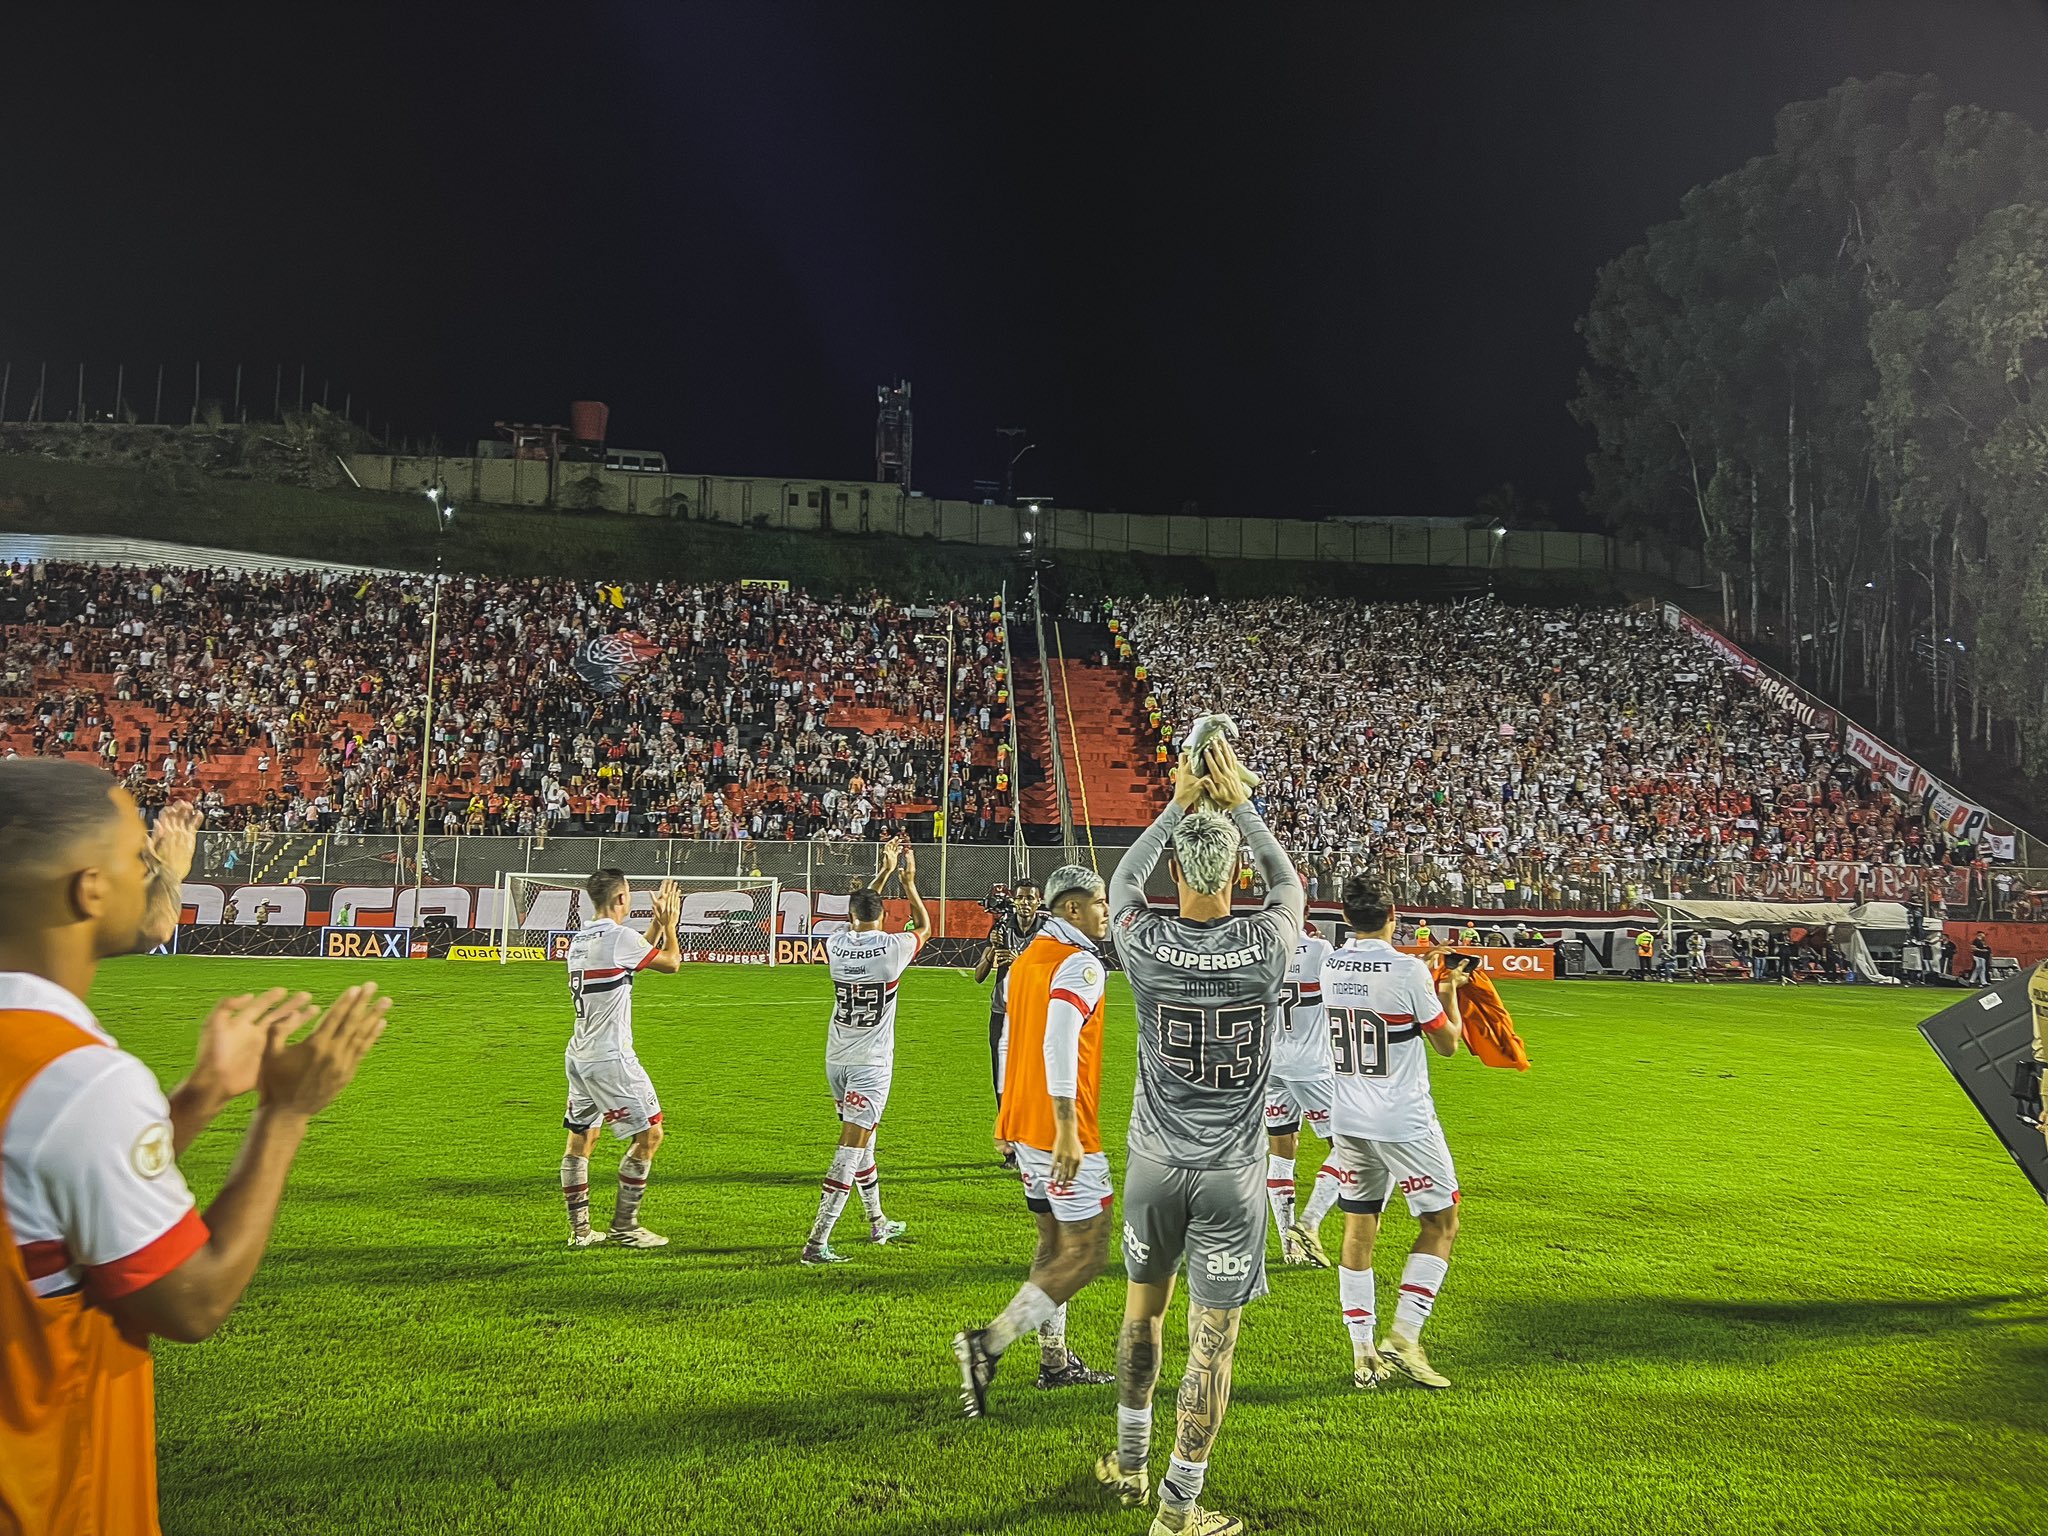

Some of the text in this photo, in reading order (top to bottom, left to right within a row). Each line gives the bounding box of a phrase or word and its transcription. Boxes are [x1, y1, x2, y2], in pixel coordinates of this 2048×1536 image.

[329, 932, 401, 957] BRAX
[778, 940, 829, 964] BRA
[832, 945, 887, 959] SUPERBET
[456, 948, 540, 960] quartzolit
[1155, 944, 1264, 971] SUPERBET
[1325, 957, 1392, 973] SUPERBET
[1502, 955, 1544, 972] GOL
[1332, 983, 1369, 997] MOREIRA
[1157, 1003, 1265, 1090] 93
[1326, 1005, 1389, 1078] 30
[1266, 1103, 1289, 1118] abc
[1304, 1108, 1330, 1121] abc
[1338, 1167, 1359, 1185] bc
[1400, 1175, 1434, 1194] abc
[1206, 1251, 1252, 1275] abc
